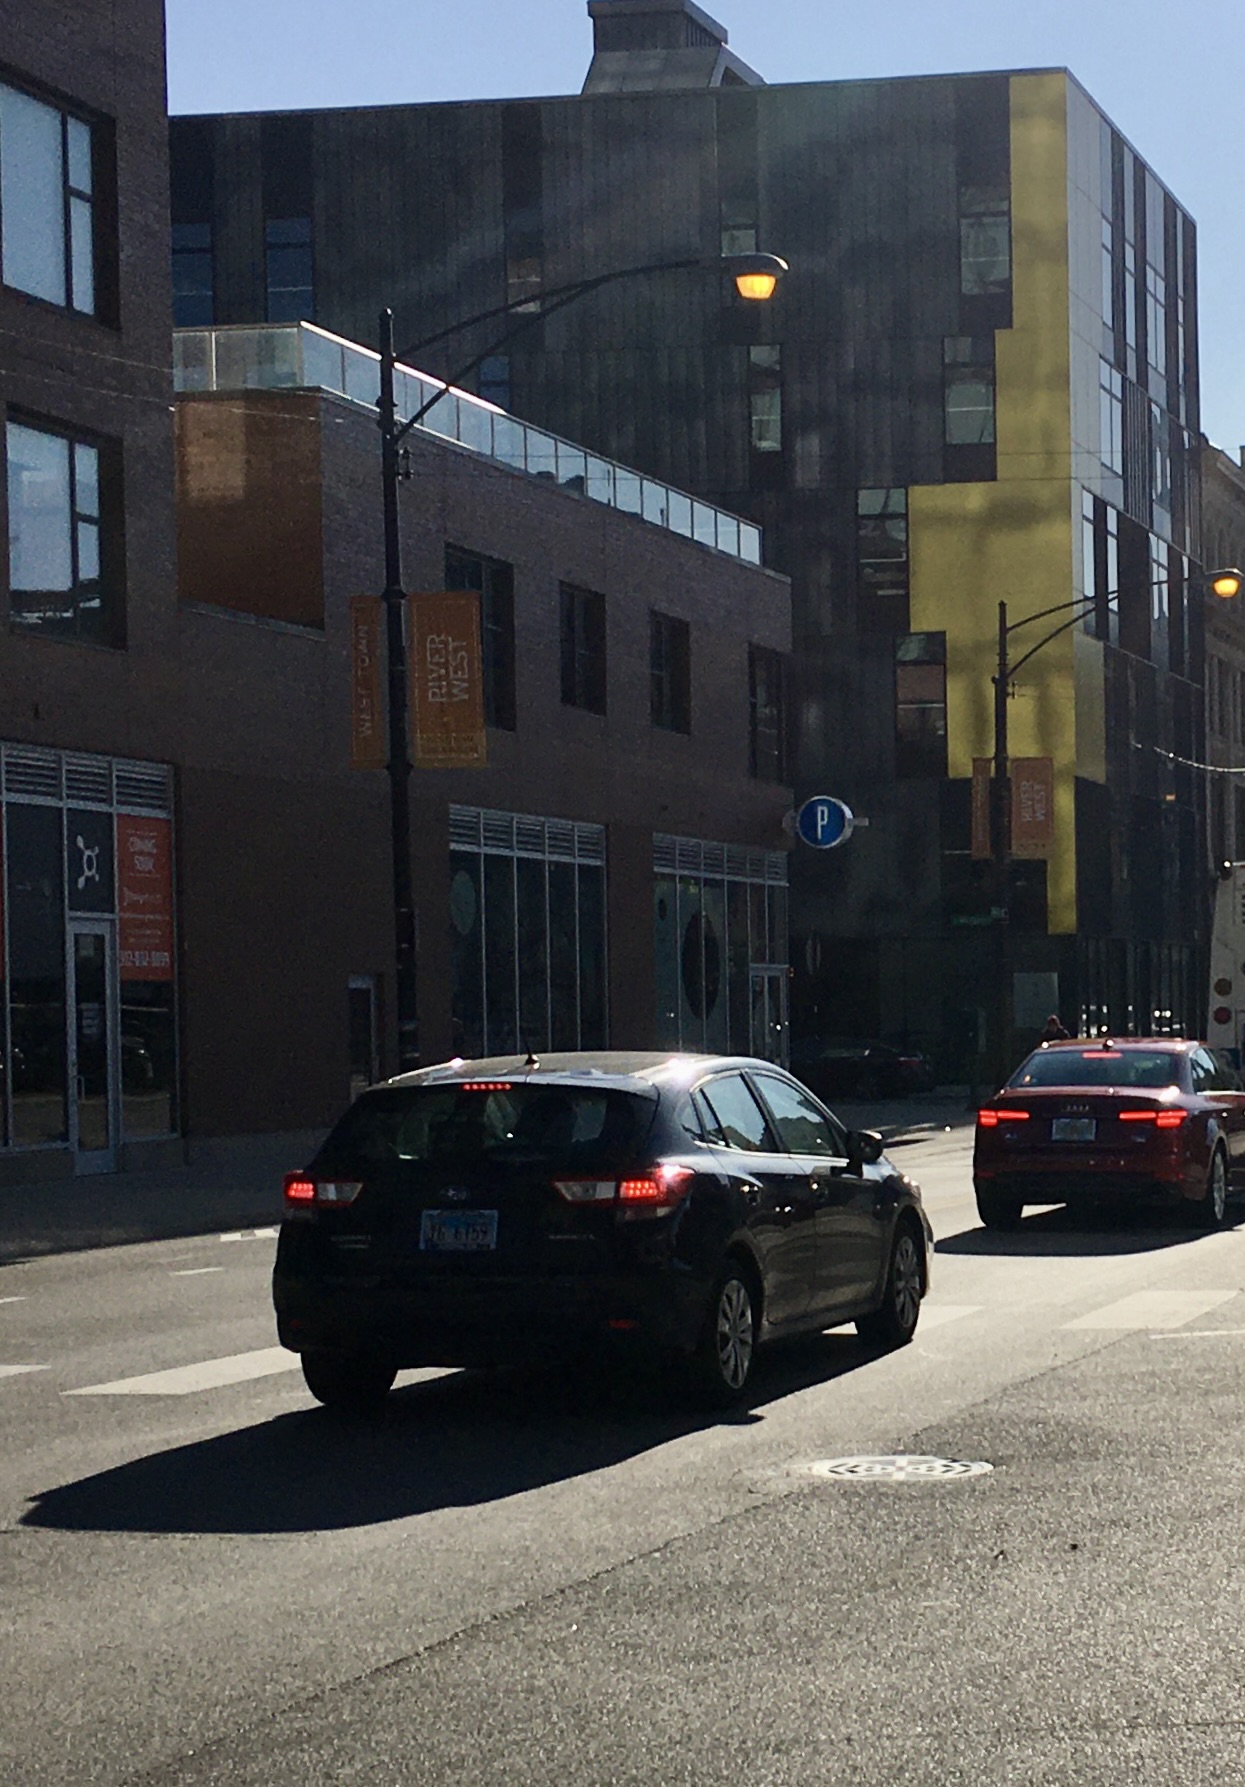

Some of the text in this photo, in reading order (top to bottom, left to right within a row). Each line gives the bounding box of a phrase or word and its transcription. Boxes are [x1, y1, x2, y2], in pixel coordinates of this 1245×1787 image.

[357, 625, 373, 738] WEST TOWN
[426, 633, 448, 703] RIVER
[448, 636, 470, 702] WEST
[816, 805, 830, 840] P
